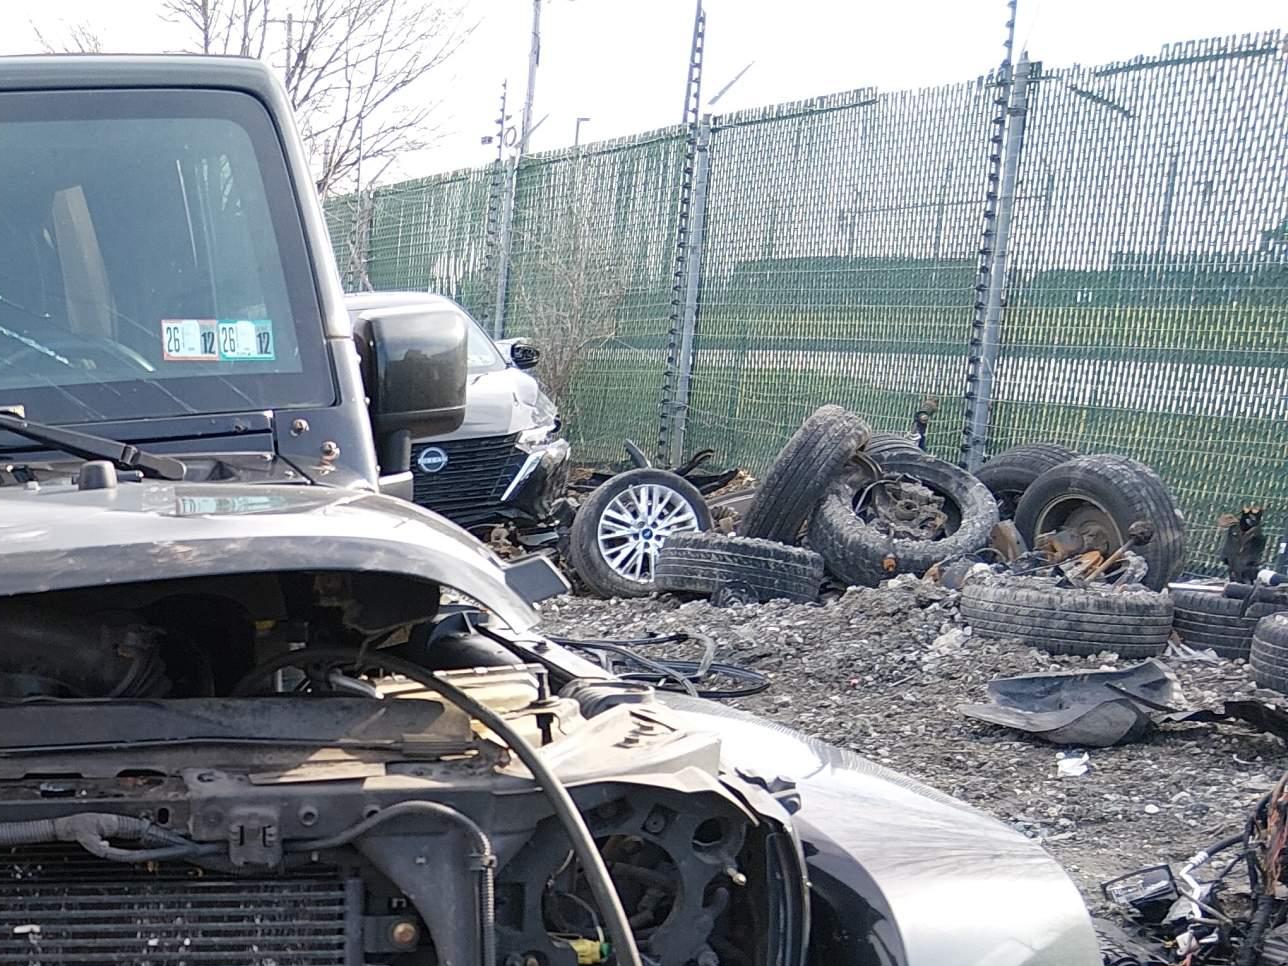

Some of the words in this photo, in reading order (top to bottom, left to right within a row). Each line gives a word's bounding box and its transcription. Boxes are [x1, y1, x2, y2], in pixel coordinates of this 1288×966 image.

[166, 326, 181, 353] 26
[201, 331, 216, 355] 12
[221, 326, 236, 353] 26
[256, 331, 272, 355] 12
